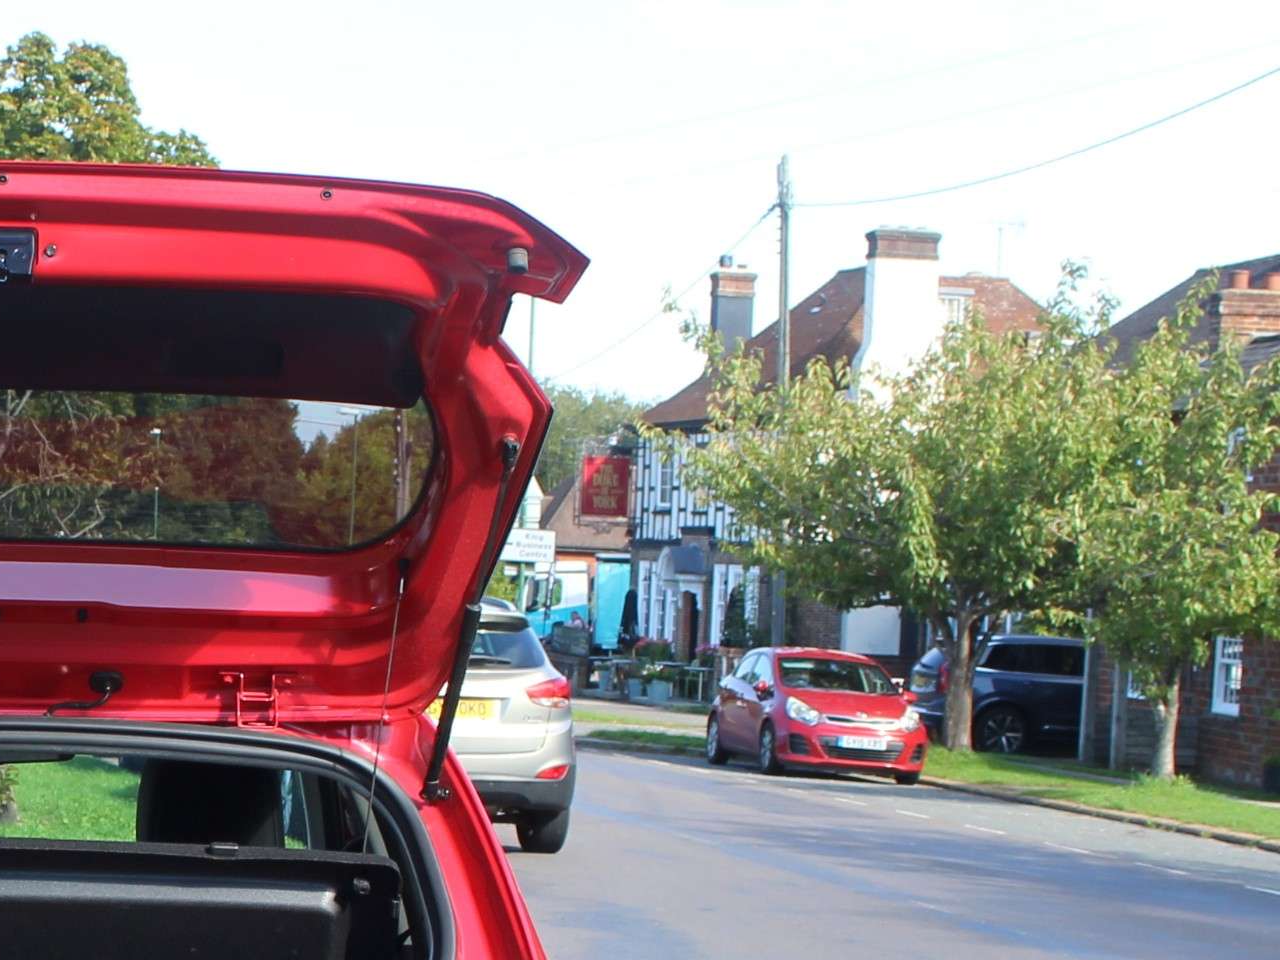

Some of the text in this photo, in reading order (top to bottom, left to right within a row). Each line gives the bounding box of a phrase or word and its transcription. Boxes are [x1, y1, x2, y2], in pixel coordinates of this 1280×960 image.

[593, 495, 618, 509] YORK
[516, 541, 552, 550] Business
[519, 550, 548, 558] Centre
